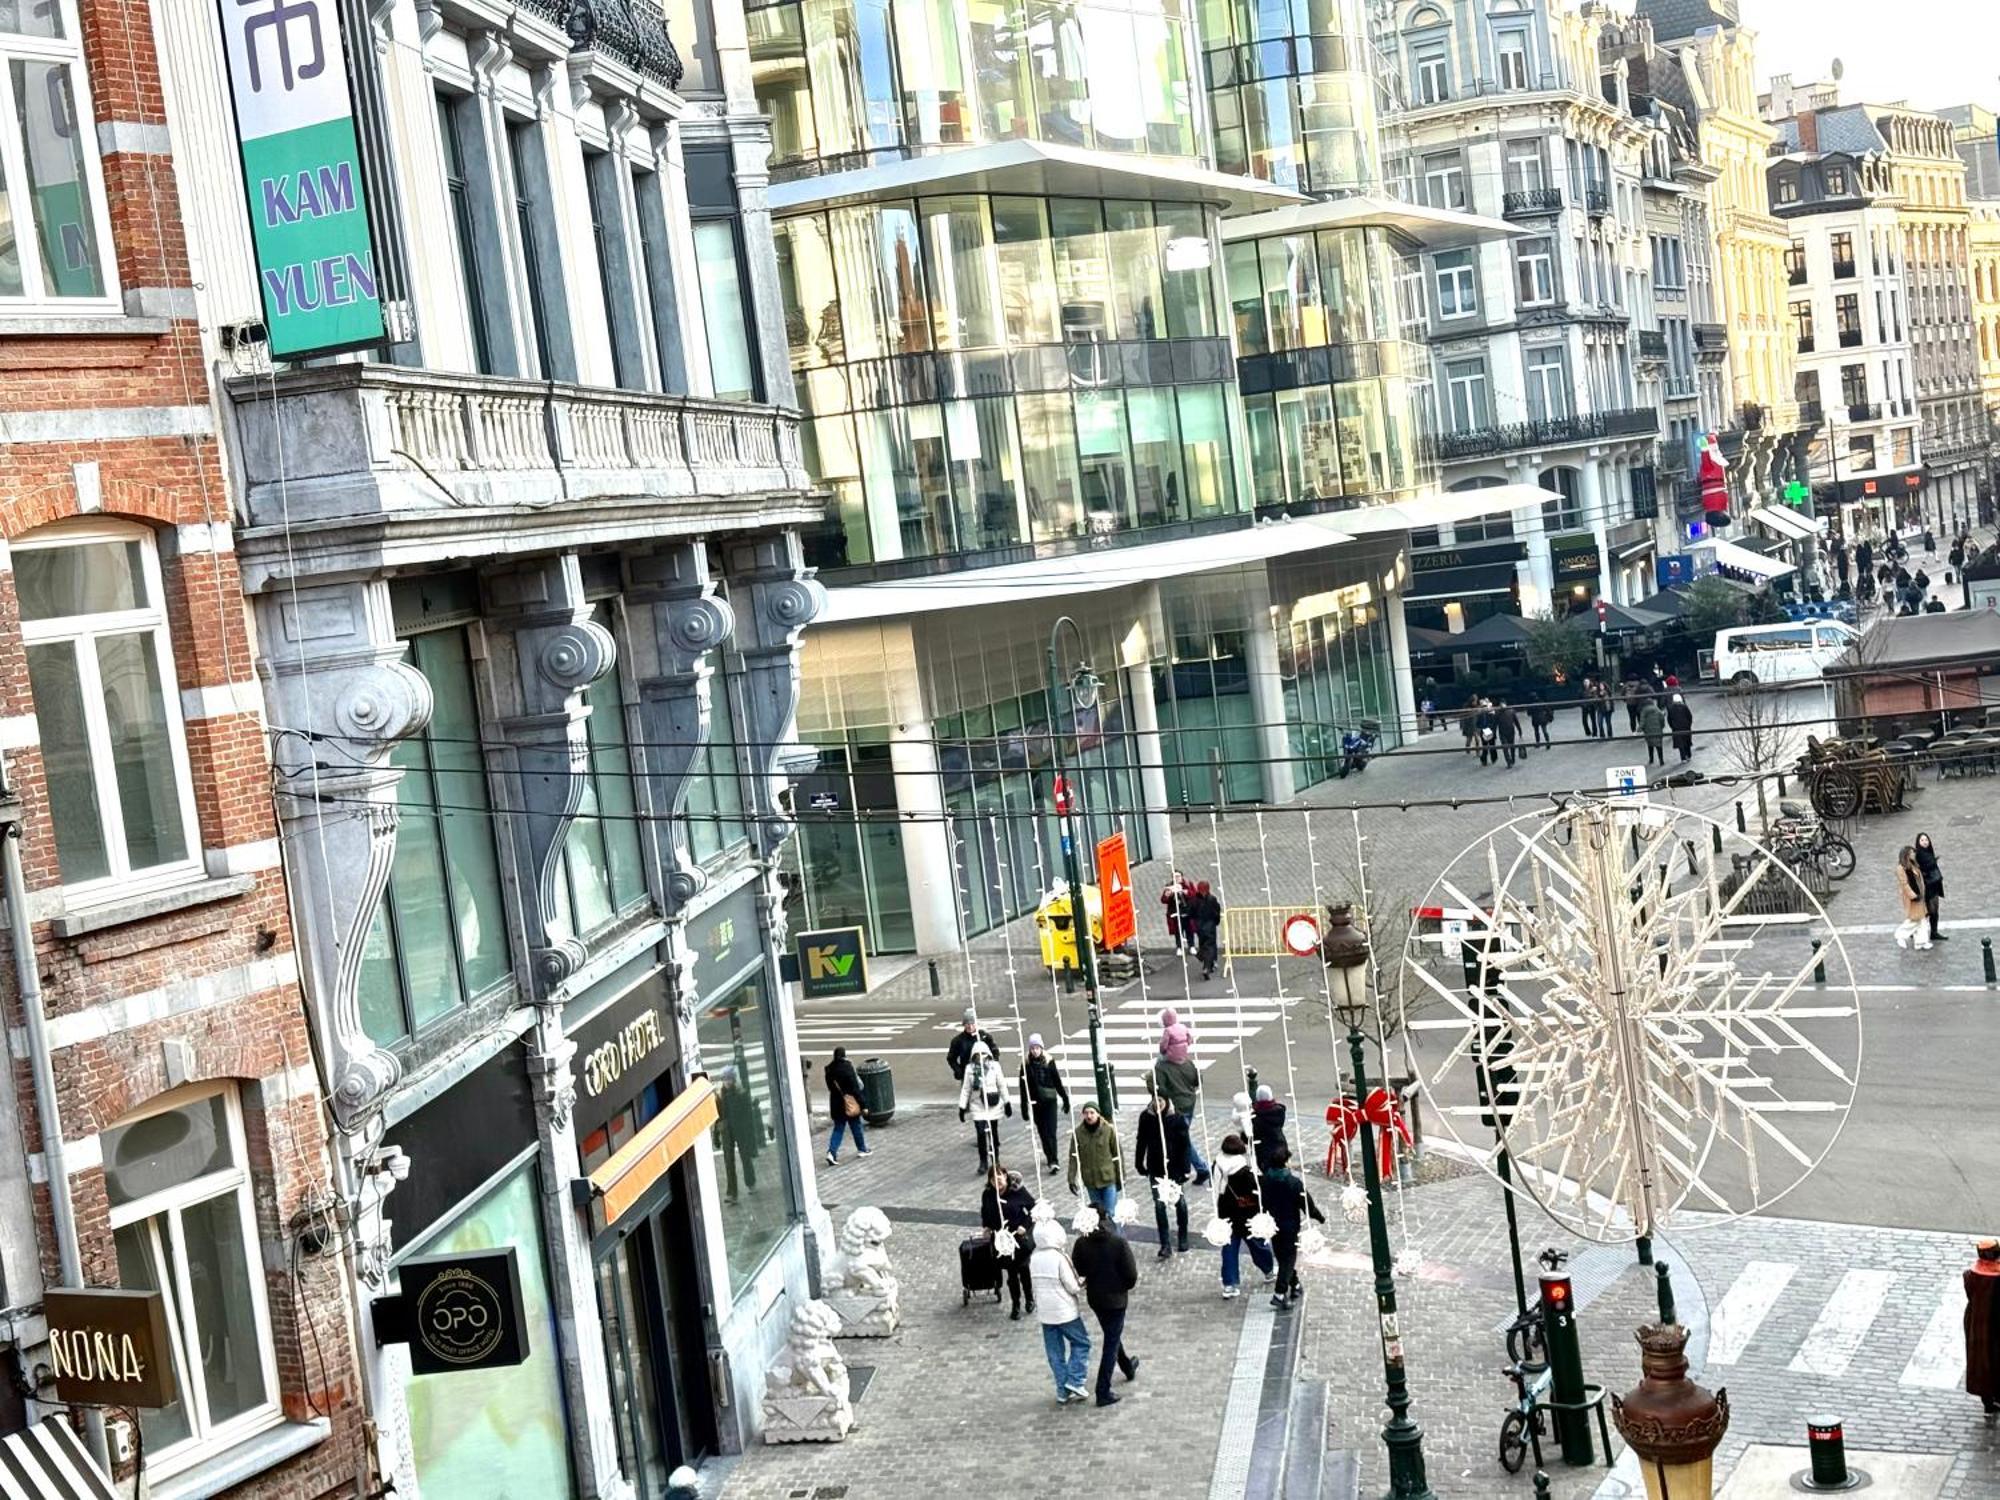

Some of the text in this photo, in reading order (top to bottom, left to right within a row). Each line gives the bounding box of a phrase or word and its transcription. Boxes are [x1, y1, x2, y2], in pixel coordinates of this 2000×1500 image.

[261, 161, 356, 227] KAM
[263, 250, 378, 316] YUEN
[1615, 768, 1637, 778] ZONE
[432, 1304, 488, 1331] OPO
[1558, 1315, 1568, 1328] 3
[49, 1328, 142, 1382] NONA
